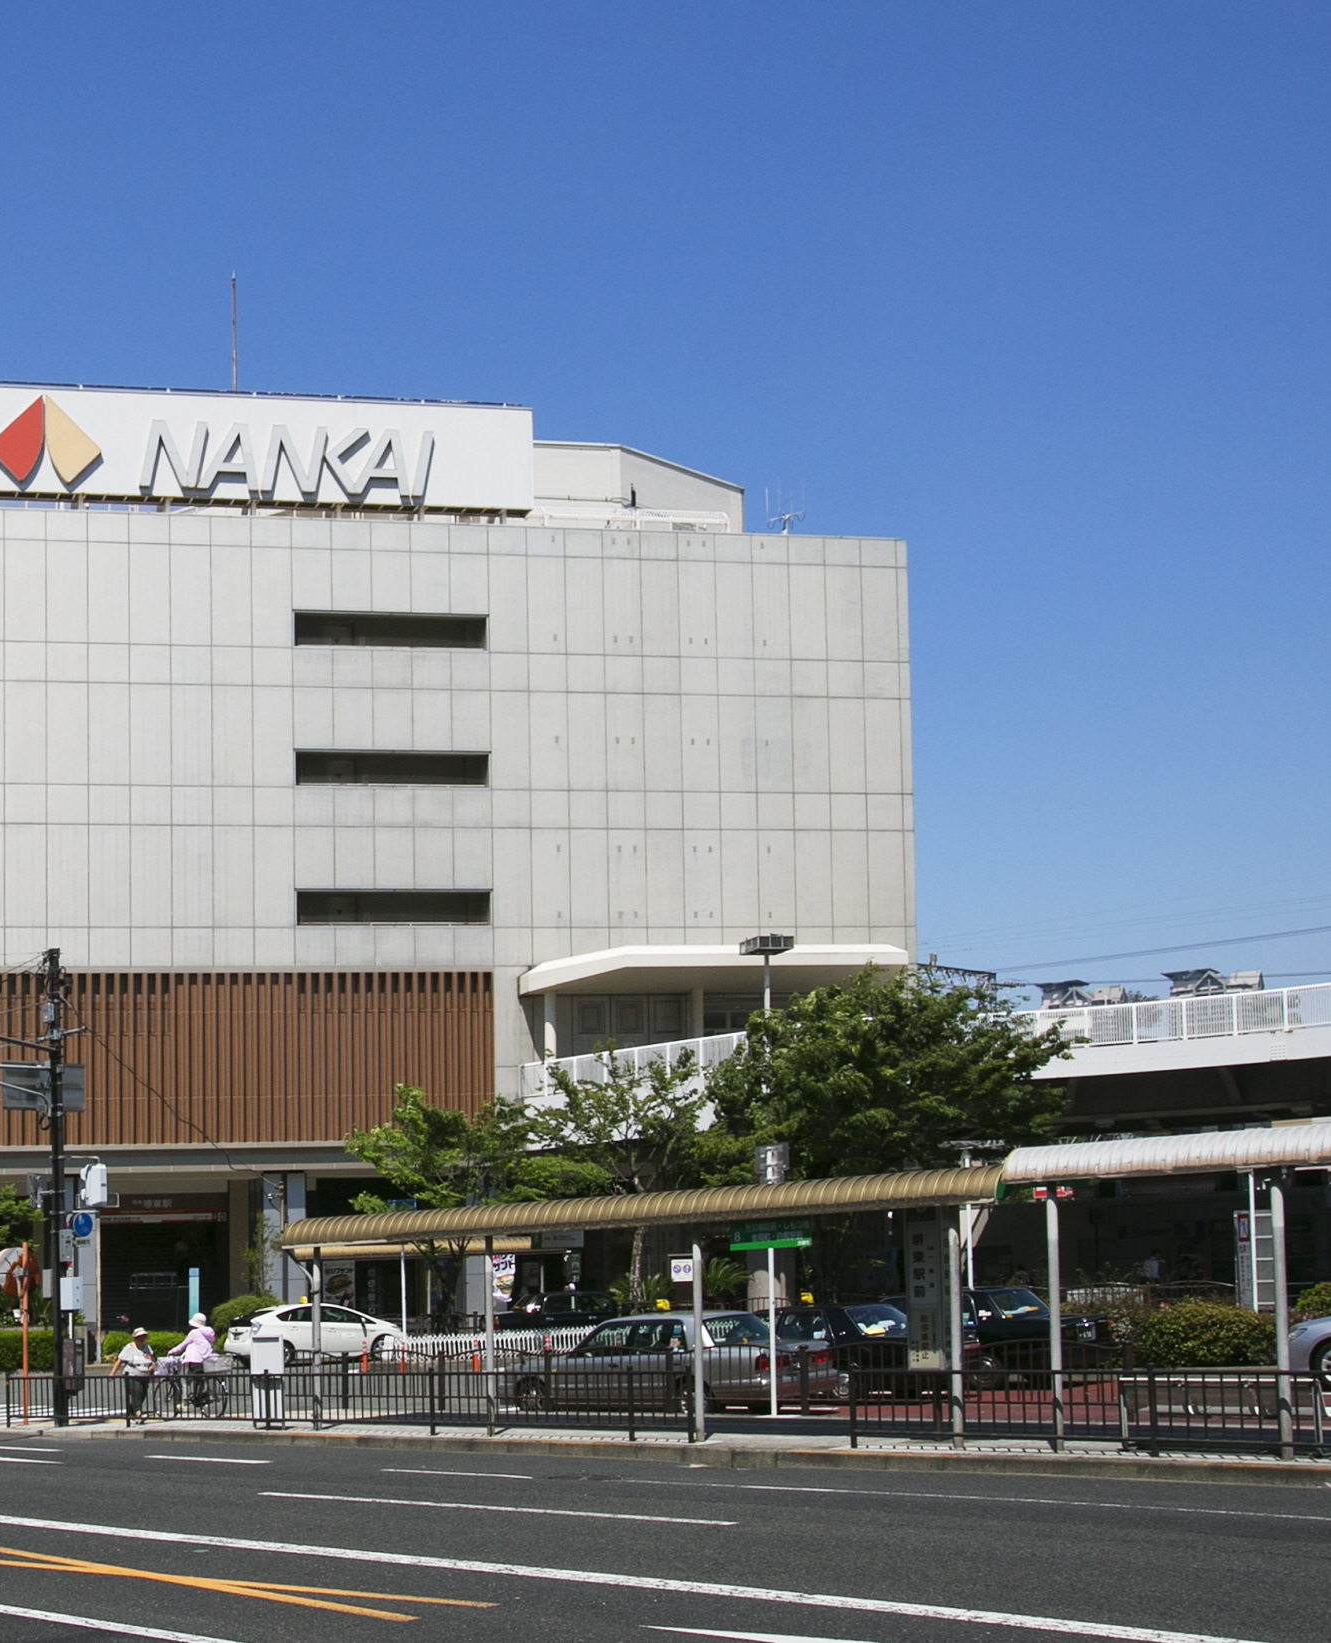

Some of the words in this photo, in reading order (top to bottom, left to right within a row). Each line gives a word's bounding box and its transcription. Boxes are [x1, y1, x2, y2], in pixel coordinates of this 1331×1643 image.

[139, 419, 435, 505] NANKAI
[733, 1231, 741, 1243] 8
[912, 1233, 926, 1298] 堺東駅前
